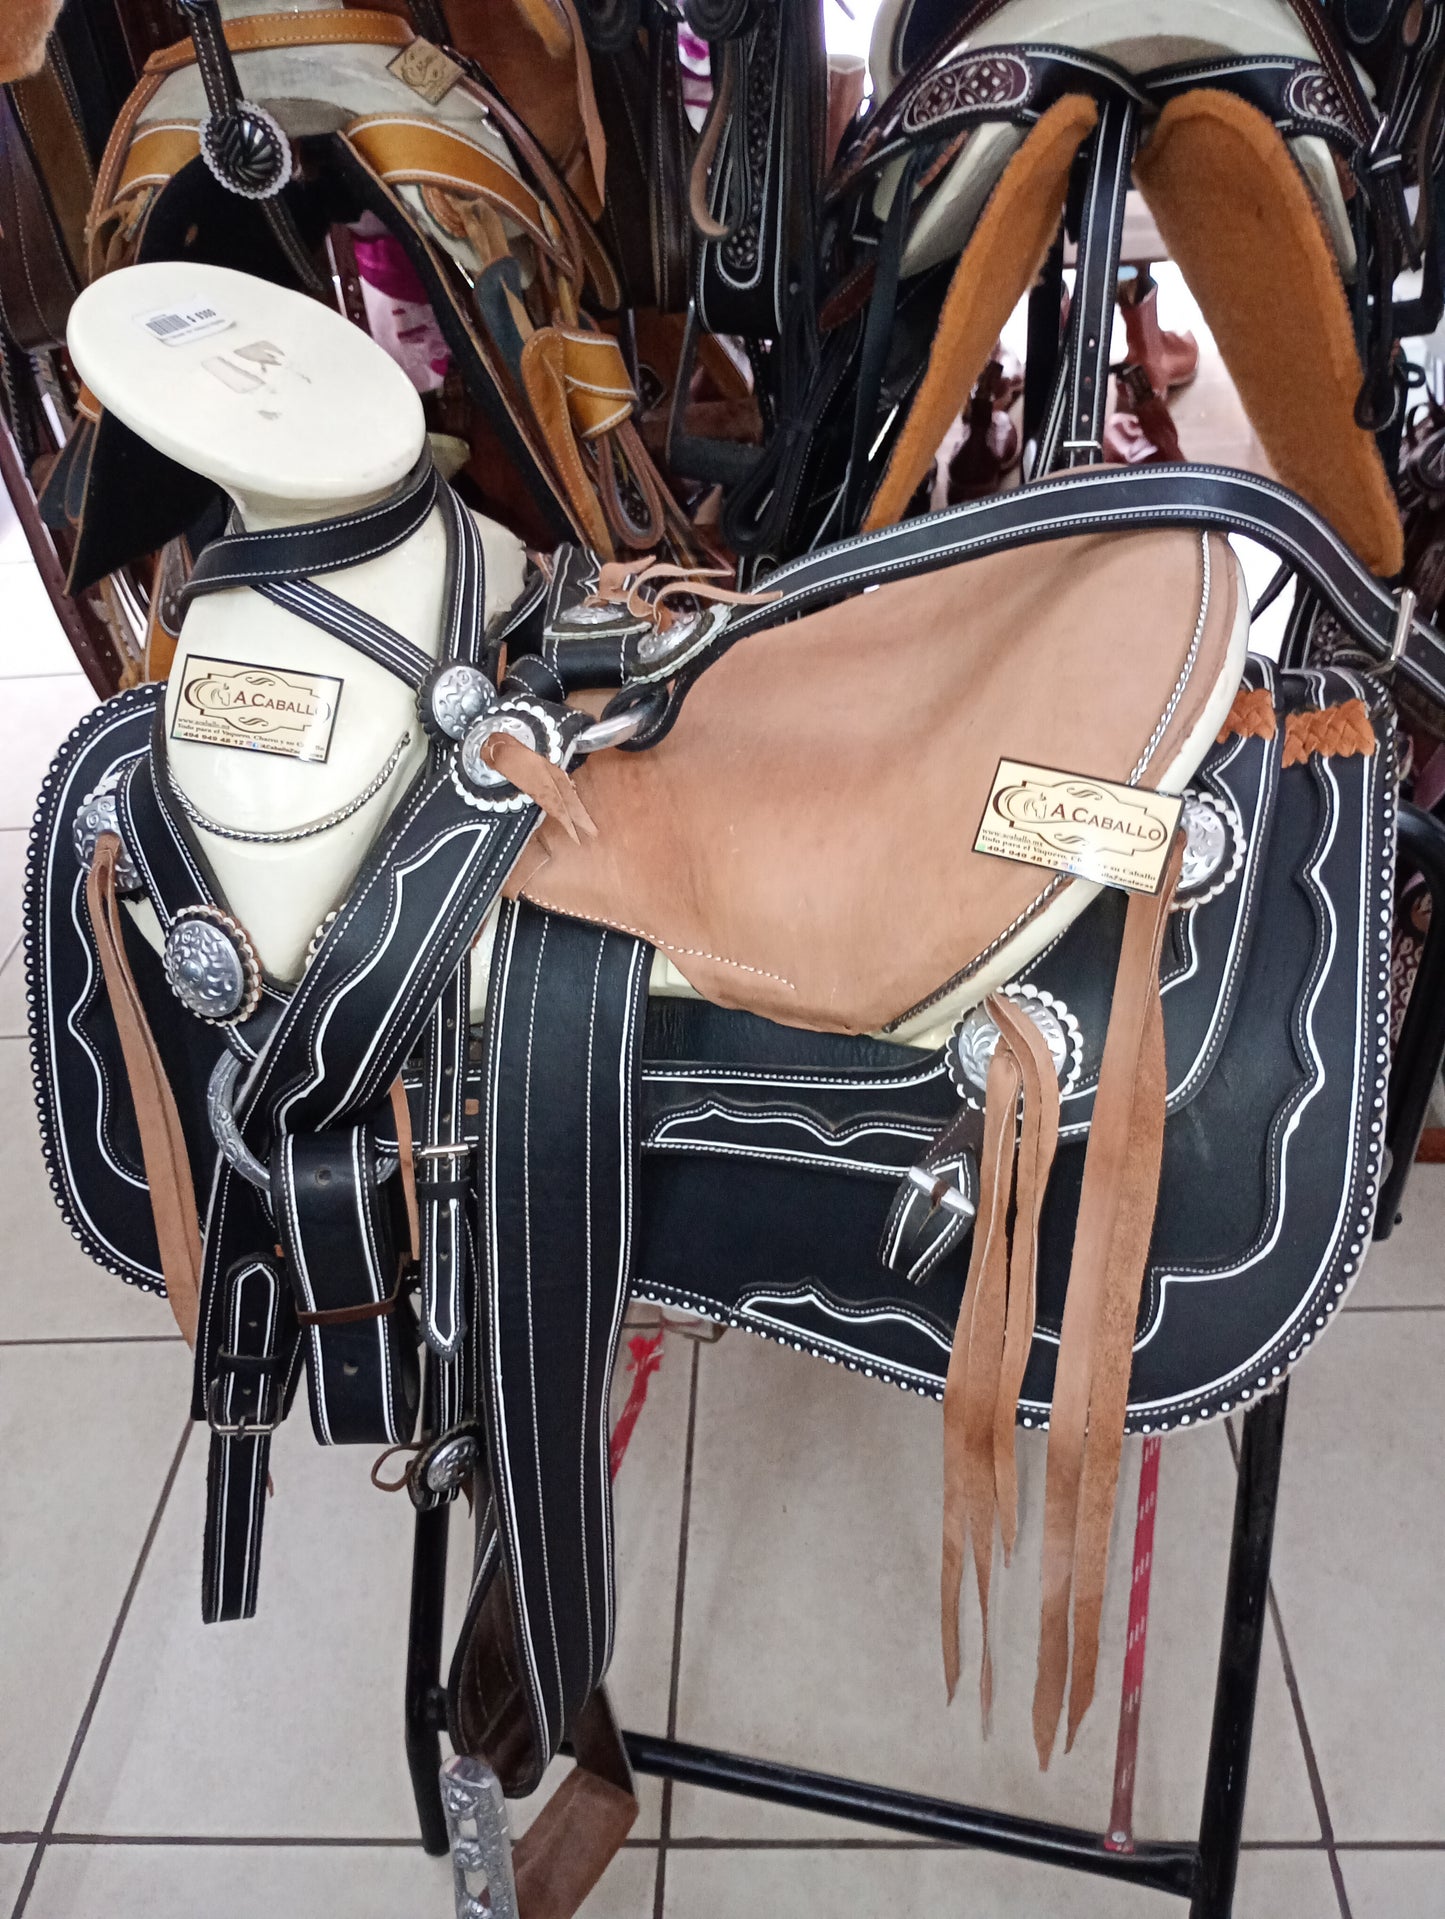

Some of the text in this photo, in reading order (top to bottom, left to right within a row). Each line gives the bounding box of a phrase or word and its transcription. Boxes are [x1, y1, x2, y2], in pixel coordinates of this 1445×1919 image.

[233, 691, 325, 716] A CABALL
[1051, 803, 1162, 841] A CABALLO
[1001, 840, 1021, 849] para
